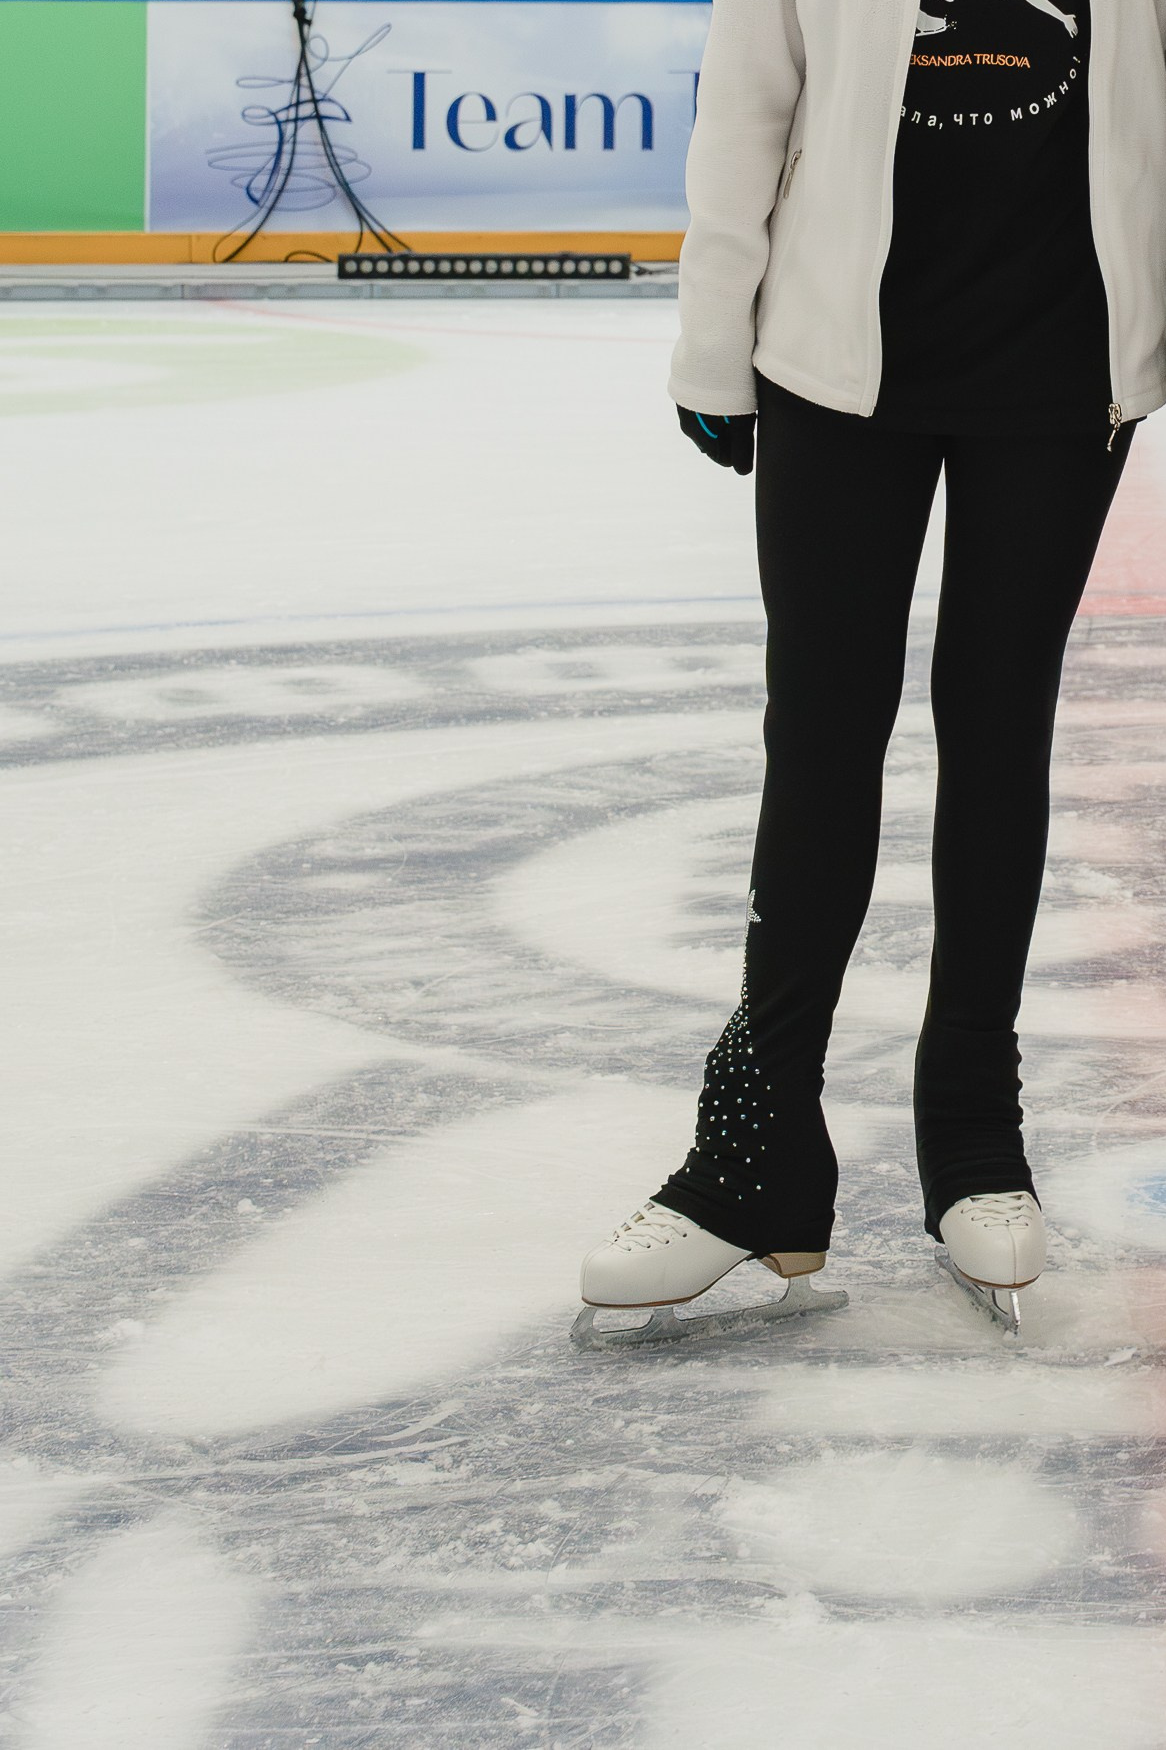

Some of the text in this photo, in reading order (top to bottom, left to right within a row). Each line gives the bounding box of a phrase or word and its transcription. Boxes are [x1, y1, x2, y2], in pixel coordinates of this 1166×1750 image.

[954, 113, 993, 126] что
[1010, 56, 1081, 121] можно!
[974, 53, 1031, 69] TRUSOVA
[387, 70, 656, 152] Team
